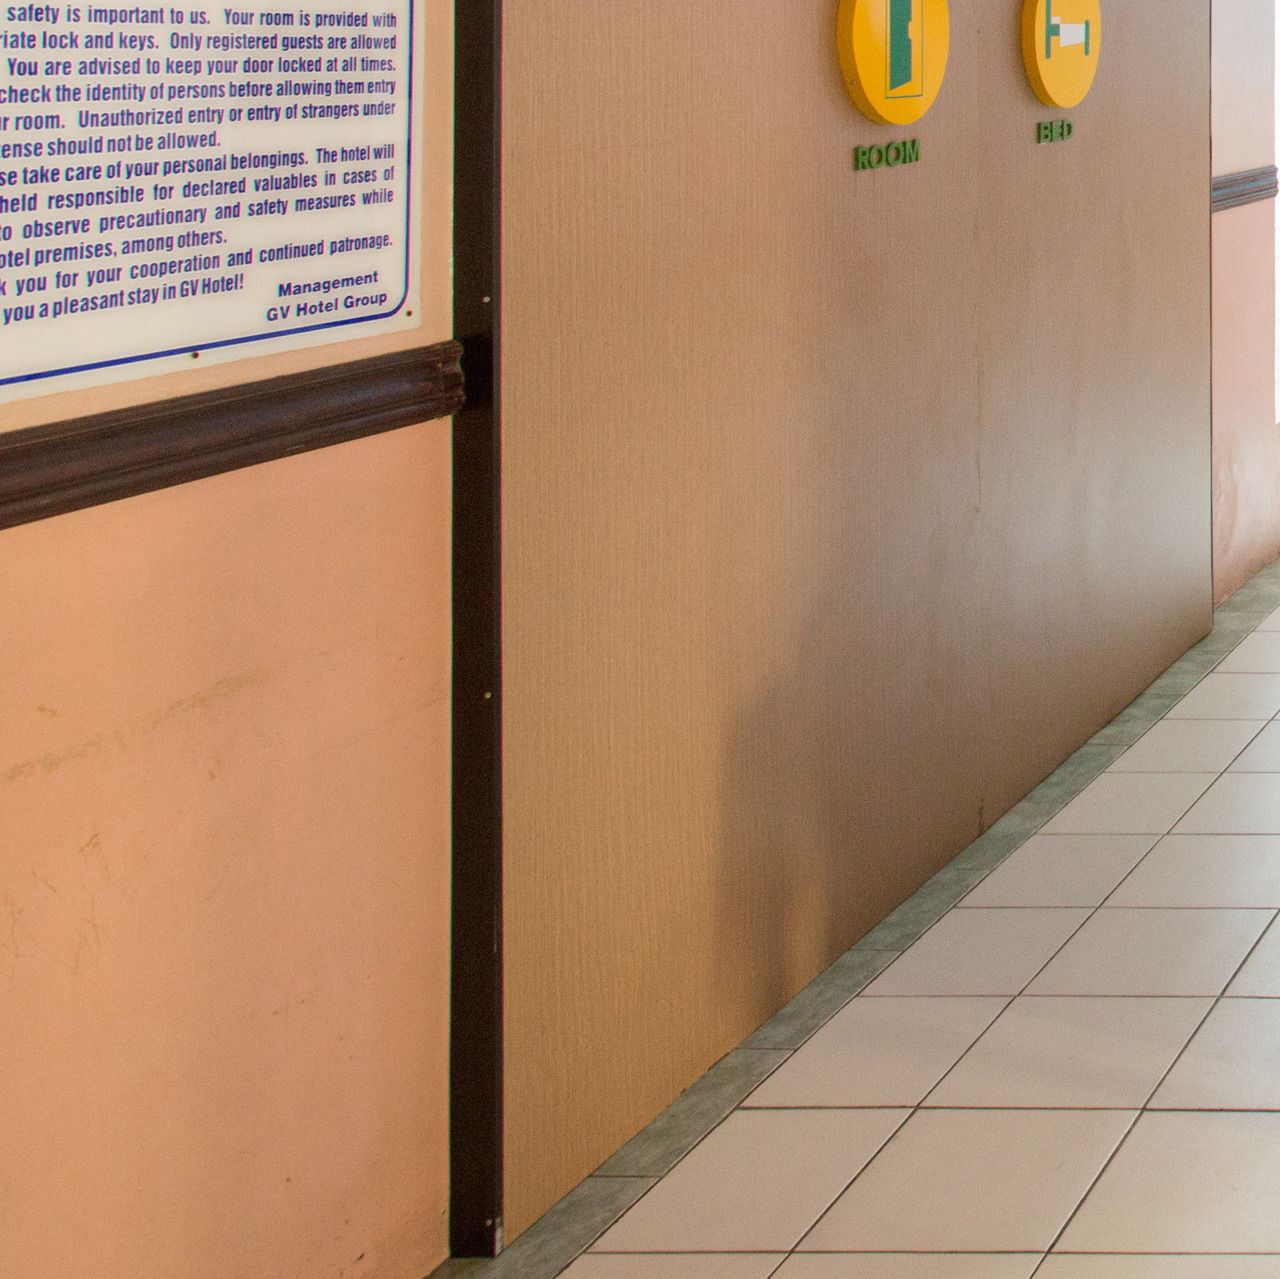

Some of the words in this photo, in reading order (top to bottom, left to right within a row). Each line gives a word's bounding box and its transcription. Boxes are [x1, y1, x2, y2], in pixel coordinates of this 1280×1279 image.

[7, 3, 60, 24] safety
[66, 4, 81, 23] is
[88, 5, 164, 25] important
[170, 8, 184, 24] to
[190, 11, 210, 25] us.
[224, 8, 255, 25] Your
[260, 12, 294, 26] room
[299, 9, 311, 26] is
[315, 11, 368, 28] provided
[372, 13, 397, 28] with
[42, 31, 79, 49] lock
[84, 31, 114, 49] and
[119, 31, 159, 51] keys.
[170, 32, 202, 51] Only
[206, 33, 278, 51] registered
[281, 34, 324, 52] guests
[327, 36, 347, 50] are
[350, 34, 397, 50] allowed
[7, 58, 38, 76] You
[44, 61, 72, 76] are
[78, 57, 141, 75] advised
[146, 58, 160, 75] to
[166, 57, 202, 76] keep
[207, 60, 238, 76] your
[242, 57, 274, 73] door
[278, 56, 322, 73] locked
[326, 57, 338, 72] at
[341, 56, 357, 72] all
[360, 56, 396, 72] times.
[55, 84, 81, 102] the
[86, 83, 146, 102] identity
[150, 82, 164, 100] of
[168, 84, 226, 102] persons
[229, 81, 273, 98] before
[276, 79, 332, 97] allowing
[334, 79, 365, 95] them
[367, 79, 396, 95] entry
[15, 114, 65, 131] room.
[78, 107, 183, 128] Unauthorized
[188, 106, 225, 125] entry
[229, 108, 243, 122] or
[247, 104, 282, 122] entry
[285, 103, 298, 120] of
[301, 103, 360, 120] strangers
[362, 100, 396, 116] under
[47, 136, 103, 156] should
[107, 135, 132, 153] not
[135, 134, 154, 151] be
[157, 130, 221, 150] allowed.
[1036, 119, 1074, 145] BED
[22, 165, 60, 185] take
[65, 165, 102, 182] care
[106, 160, 122, 179] of
[125, 162, 160, 180] your
[163, 154, 227, 177] personal
[230, 150, 308, 170] belongings.
[316, 148, 338, 164] The
[340, 145, 370, 162] hotel
[373, 144, 394, 160] will
[853, 139, 920, 171] ROOM
[0, 193, 38, 214] held
[48, 185, 144, 210] responsible
[153, 183, 174, 200] for
[182, 177, 246, 198] declared
[254, 172, 317, 192] valuables
[324, 170, 336, 186] in
[343, 169, 377, 185] cases
[383, 165, 394, 181] of
[22, 218, 90, 239] observe
[99, 208, 207, 234] precautionary
[215, 201, 241, 220] and
[247, 198, 288, 217] safety
[295, 194, 356, 212] measures
[362, 188, 394, 205] while
[34, 242, 117, 267] premises,
[121, 236, 174, 255] among
[177, 230, 227, 248] others.
[16, 276, 47, 297] you
[55, 271, 79, 289] for
[87, 267, 123, 287] your
[130, 254, 220, 279] cooperation
[227, 248, 253, 267] and
[259, 239, 324, 263] continued
[330, 234, 392, 256] patronage.
[278, 270, 378, 297] Management
[3, 305, 35, 326] you
[38, 303, 49, 318] a
[52, 290, 125, 319] pleasant
[127, 287, 160, 305] stay
[162, 283, 176, 300] in
[180, 279, 199, 298] GV
[202, 273, 244, 295] Hotel!
[266, 305, 291, 322] GV
[296, 297, 339, 317] Hotel
[343, 293, 387, 309] Group
